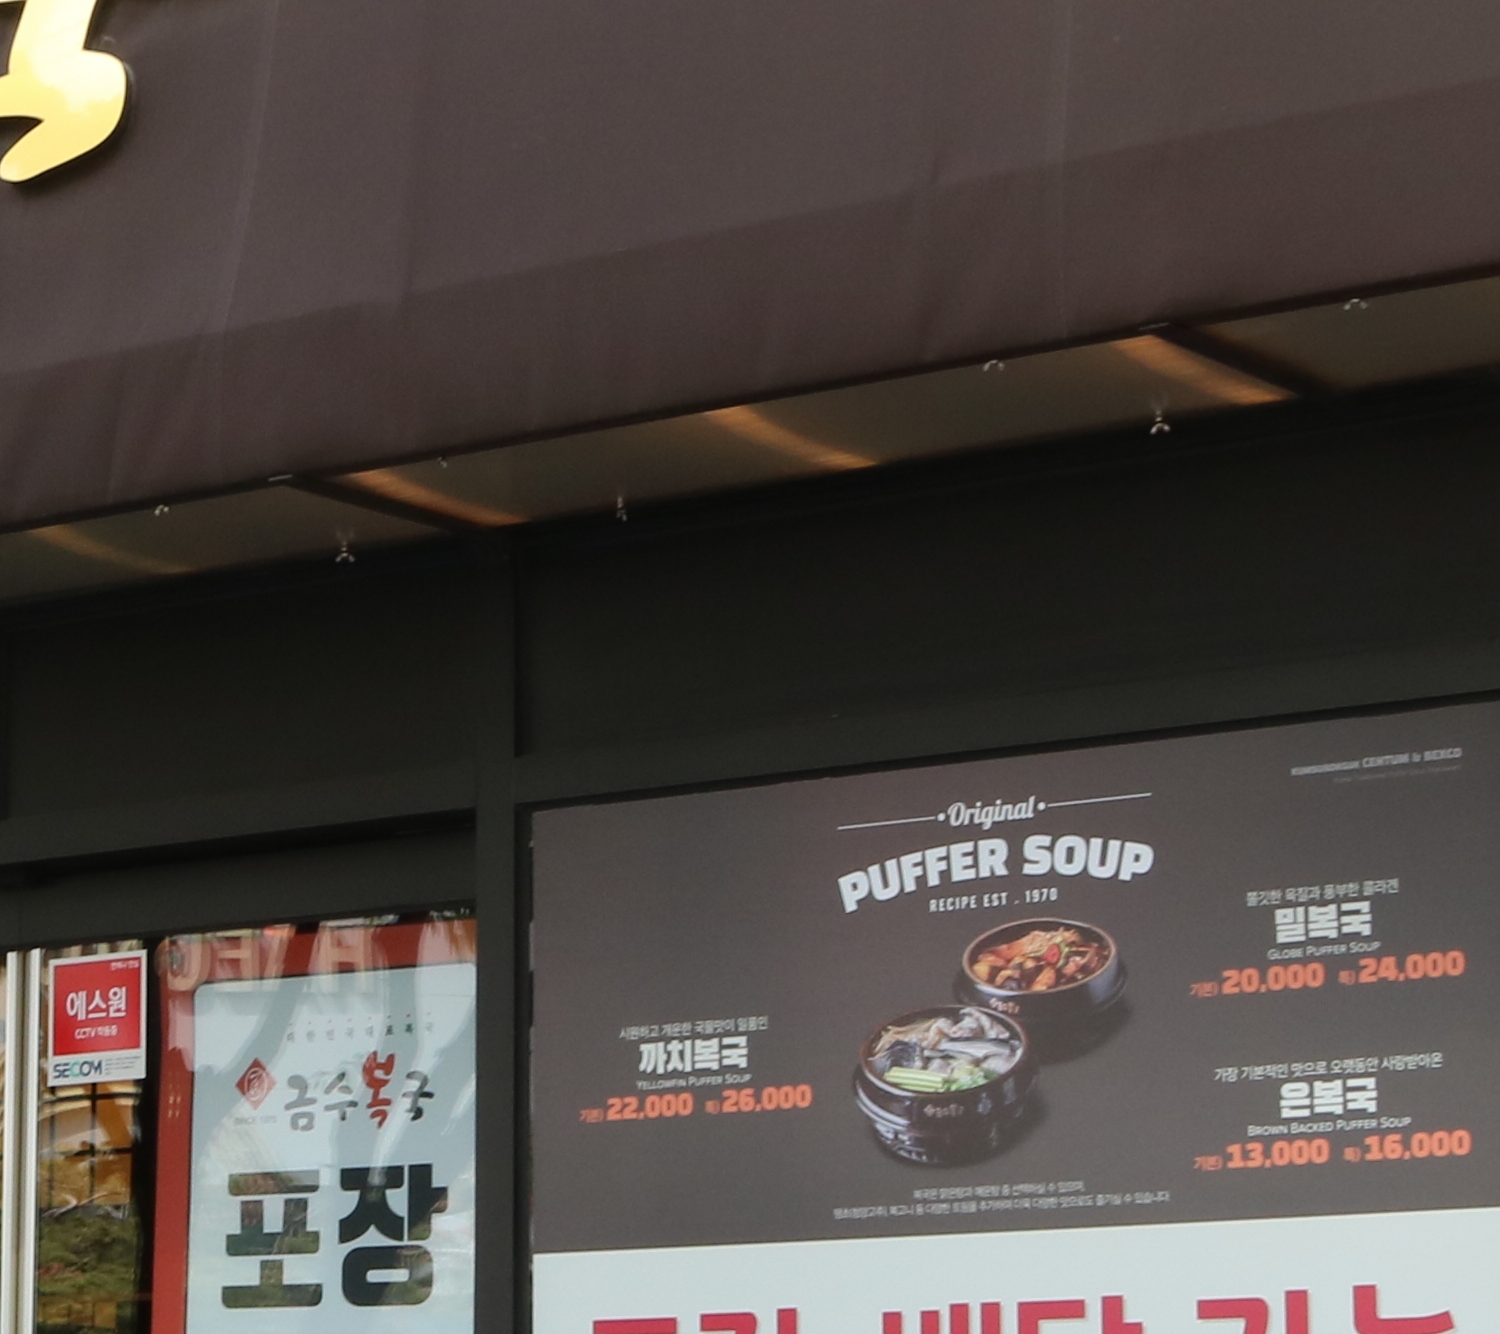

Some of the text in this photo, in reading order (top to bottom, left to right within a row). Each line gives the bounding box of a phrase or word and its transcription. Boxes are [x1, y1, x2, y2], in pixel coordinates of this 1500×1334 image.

[947, 796, 1036, 830] Original
[837, 834, 1155, 914] PUFFER SOUP
[929, 888, 1058, 913] RECIPE EST 1970
[1274, 900, 1373, 944] 밀복국
[1221, 951, 1466, 995] 20,000 24,000
[66, 986, 128, 1021] 에스원
[53, 1060, 103, 1079] SECOM
[639, 1036, 749, 1075] 까치복국
[284, 1051, 435, 1132] 금수복국
[607, 1084, 813, 1122] 22,000 26,000
[1279, 1077, 1378, 1119] 은복국
[1226, 1130, 1472, 1169] 13,000 16,000
[221, 1163, 449, 1309] 포장
